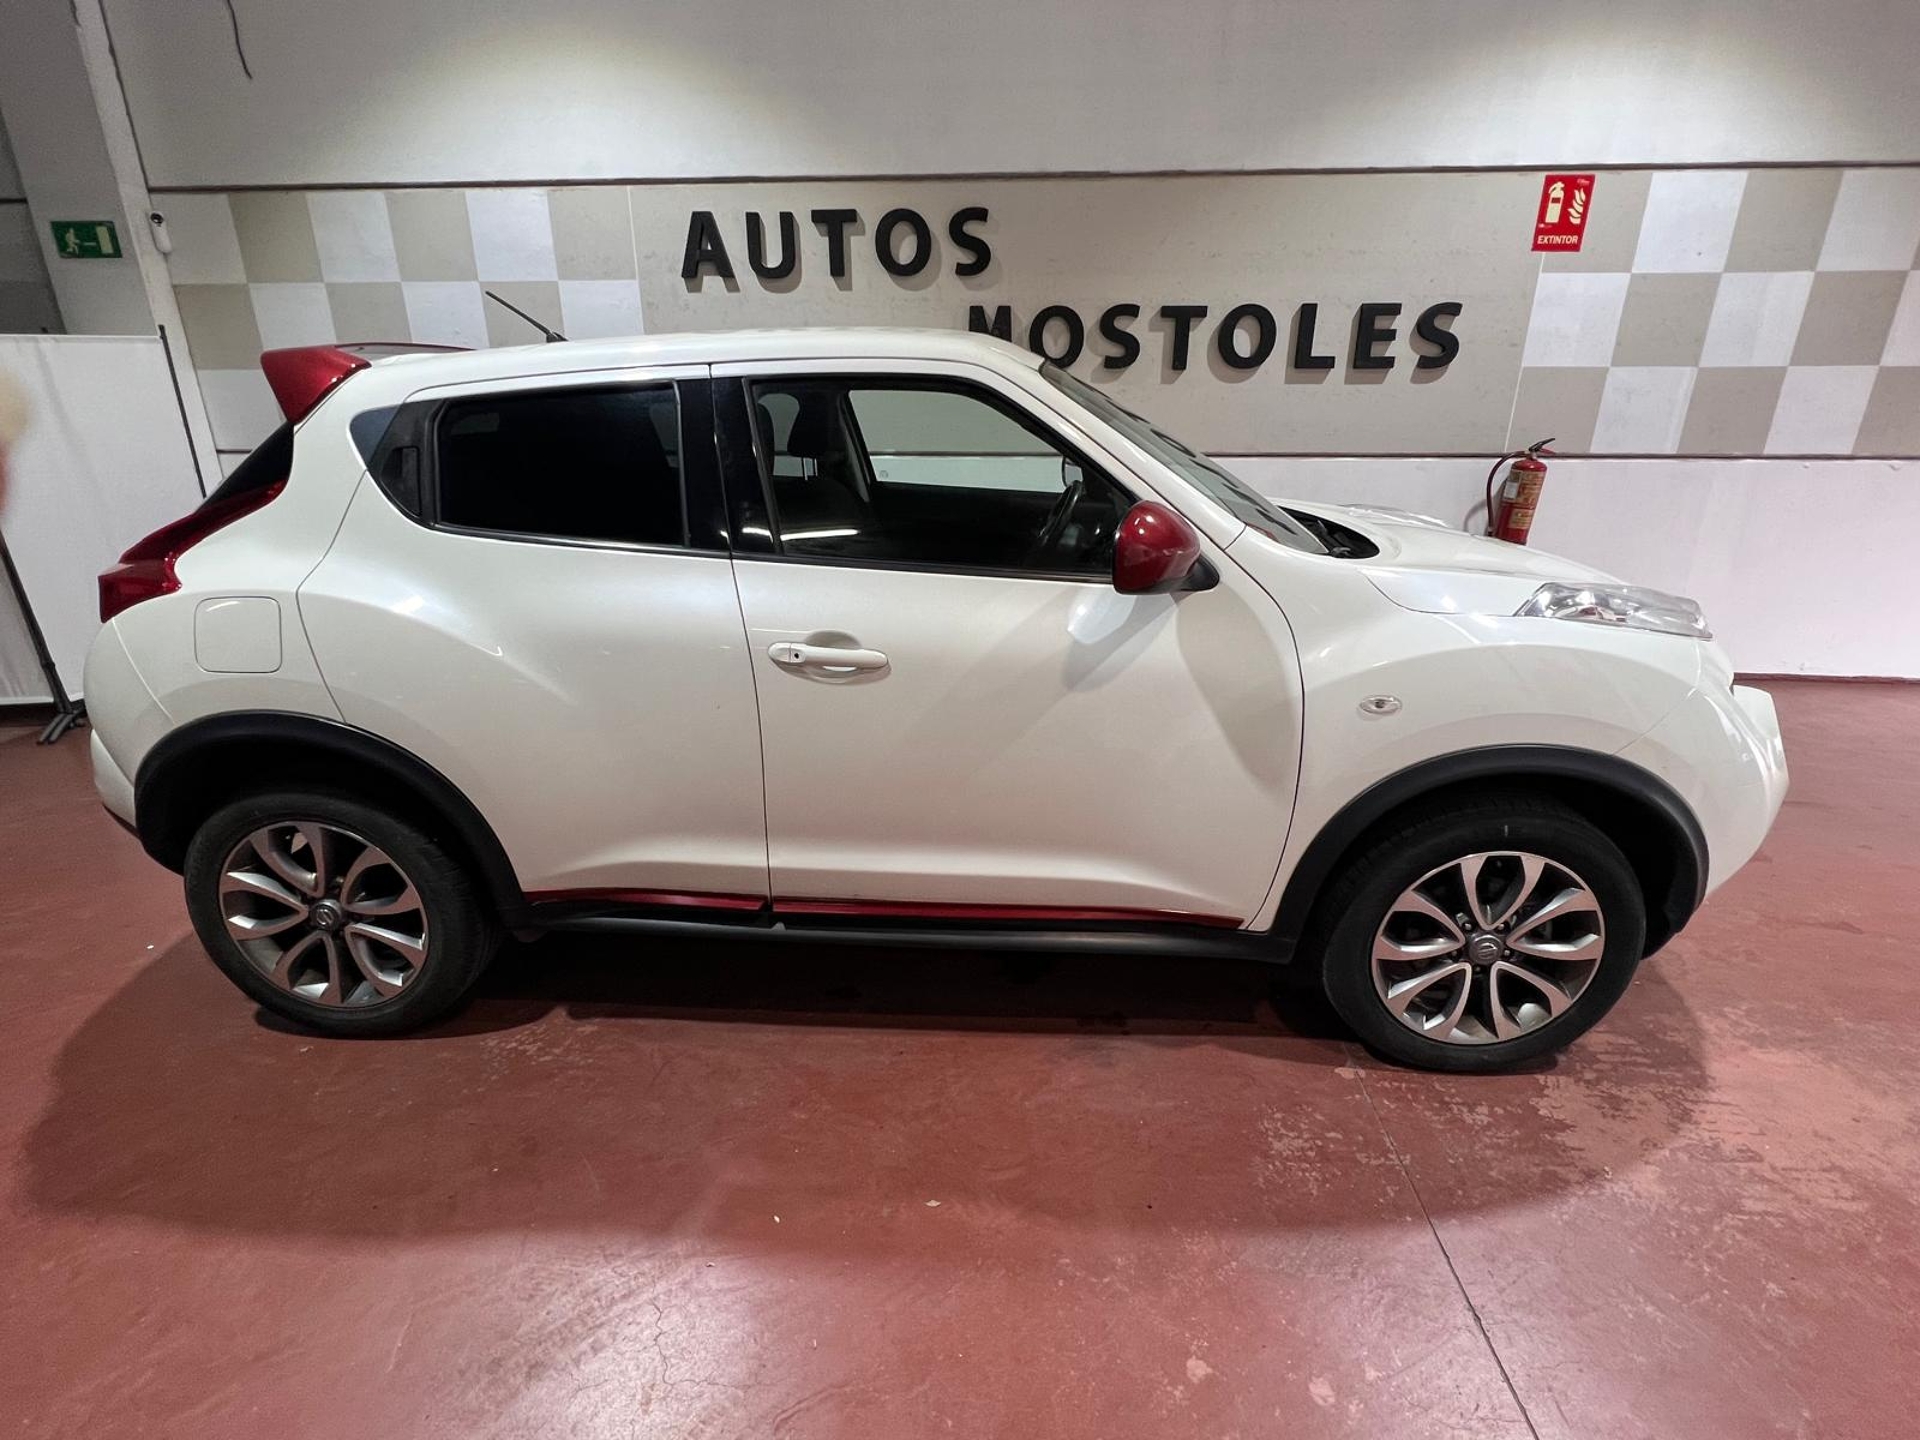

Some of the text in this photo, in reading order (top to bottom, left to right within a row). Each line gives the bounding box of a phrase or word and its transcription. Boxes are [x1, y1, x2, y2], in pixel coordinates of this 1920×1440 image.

[681, 207, 992, 279] AUTOS
[1537, 235, 1579, 245] EXTINTOR
[968, 302, 1463, 369] MOSTOLES
